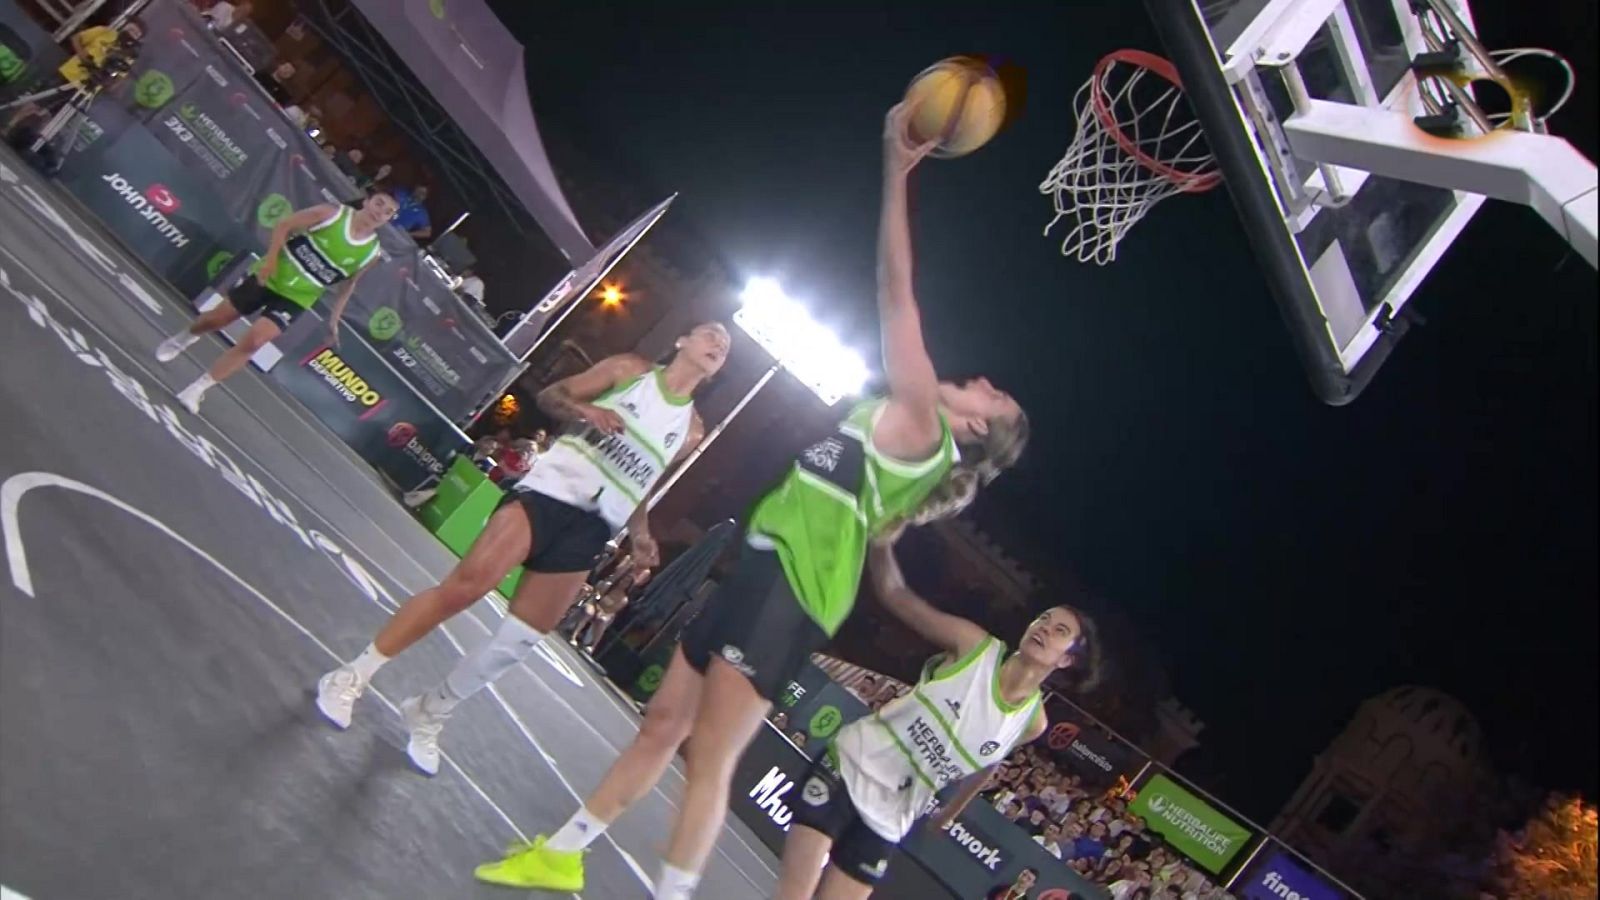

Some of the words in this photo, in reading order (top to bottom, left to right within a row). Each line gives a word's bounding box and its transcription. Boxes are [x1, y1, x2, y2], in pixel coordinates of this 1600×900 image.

[102, 173, 147, 209] JOHN
[141, 206, 190, 248] SMITH
[308, 359, 357, 402] DEPORTIVO
[316, 349, 380, 406] MUNDO
[406, 436, 445, 474] balonc
[1161, 810, 1227, 857] NUTRITION
[1166, 803, 1232, 849] HERBALIFE
